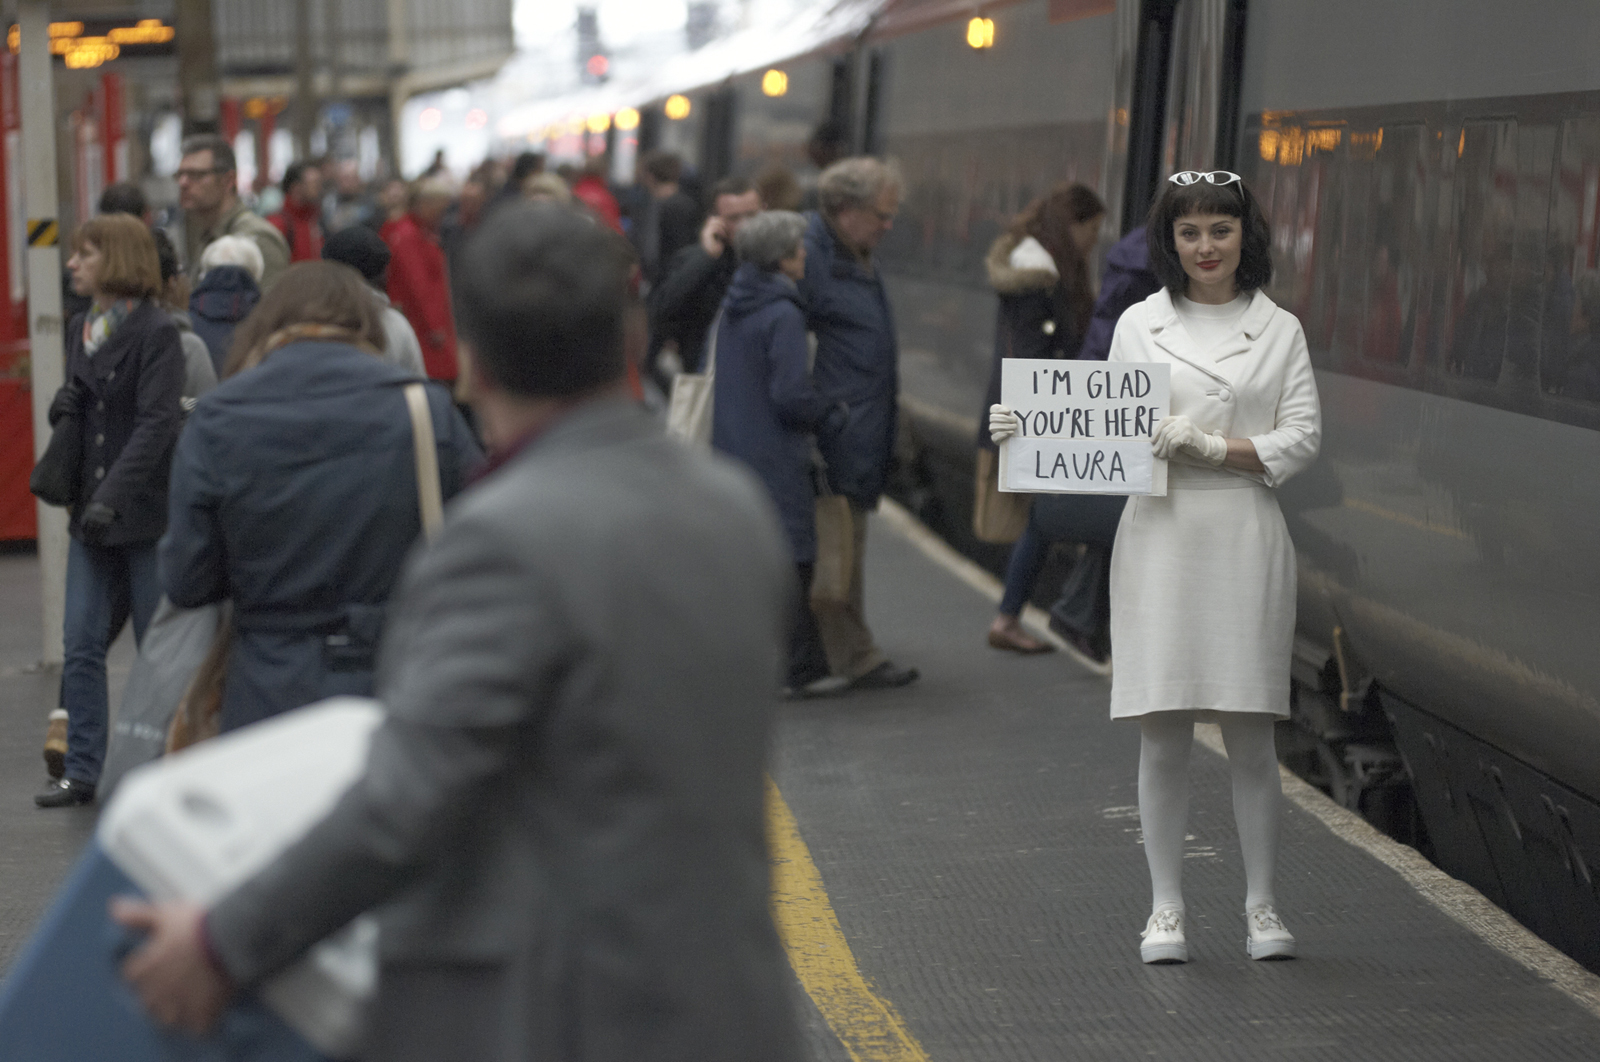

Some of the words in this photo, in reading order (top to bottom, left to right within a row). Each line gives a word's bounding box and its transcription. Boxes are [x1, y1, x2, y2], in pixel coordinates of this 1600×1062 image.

[1033, 369, 1071, 395] I'M
[1087, 369, 1151, 399] GLAD
[1013, 407, 1095, 438] YOU'RE
[1035, 450, 1126, 482] LAURA
